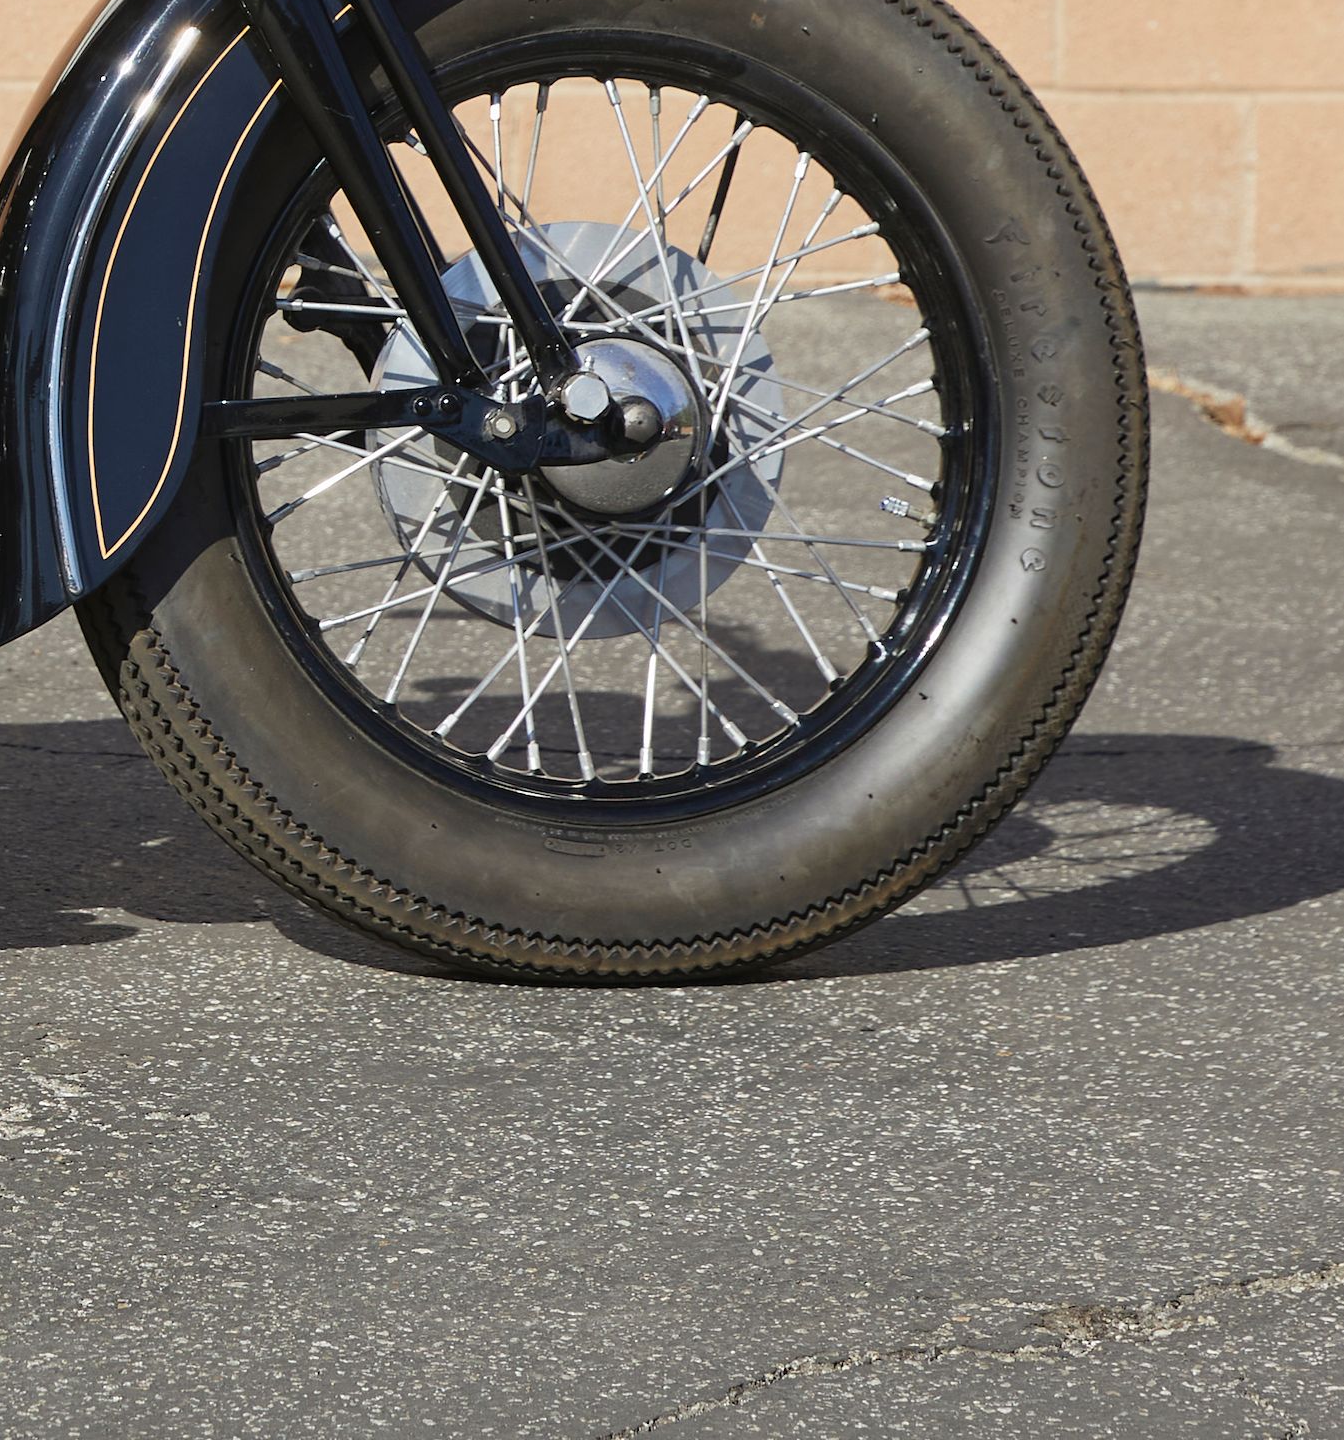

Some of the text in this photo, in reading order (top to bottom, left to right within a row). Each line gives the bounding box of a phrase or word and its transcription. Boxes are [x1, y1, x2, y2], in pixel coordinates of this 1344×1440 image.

[992, 289, 1030, 519] DELUXE CHAMPION
[655, 838, 693, 852] DOT
